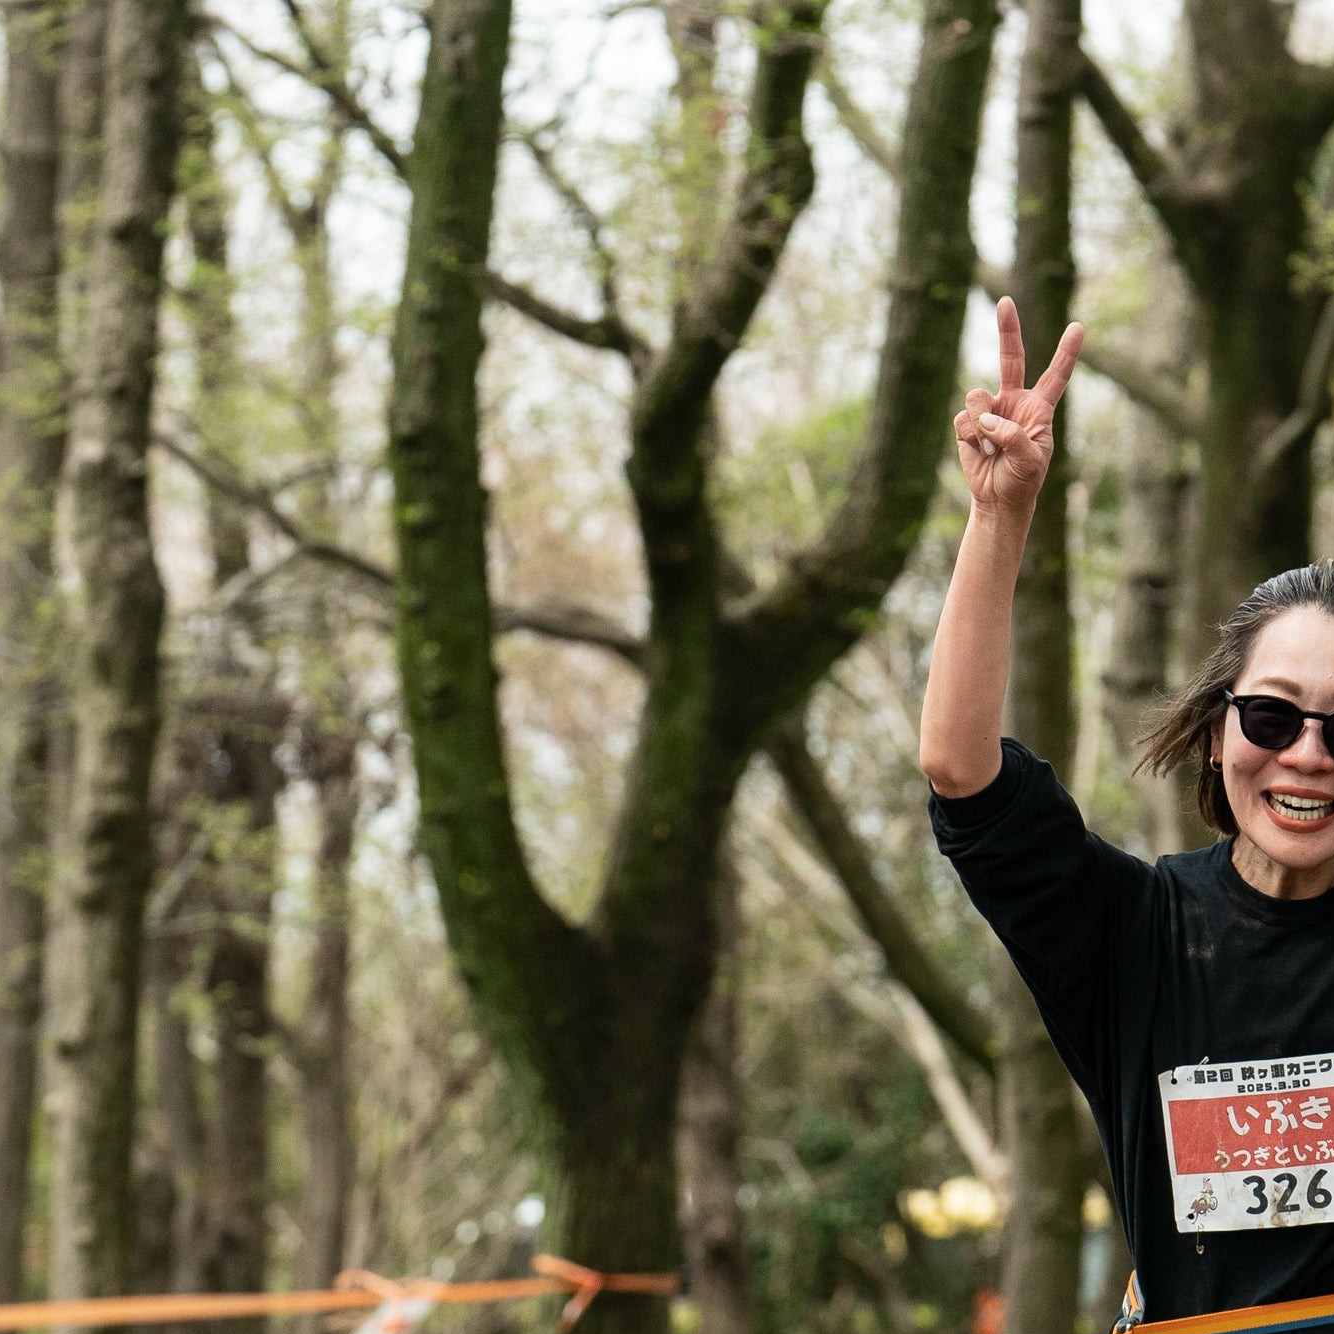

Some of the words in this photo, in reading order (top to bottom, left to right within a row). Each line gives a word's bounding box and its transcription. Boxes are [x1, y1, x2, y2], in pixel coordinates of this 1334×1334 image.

[1237, 1078, 1311, 1094] 2025.3.30
[1226, 1095, 1332, 1136] いぶき
[1242, 1168, 1333, 1215] 326
